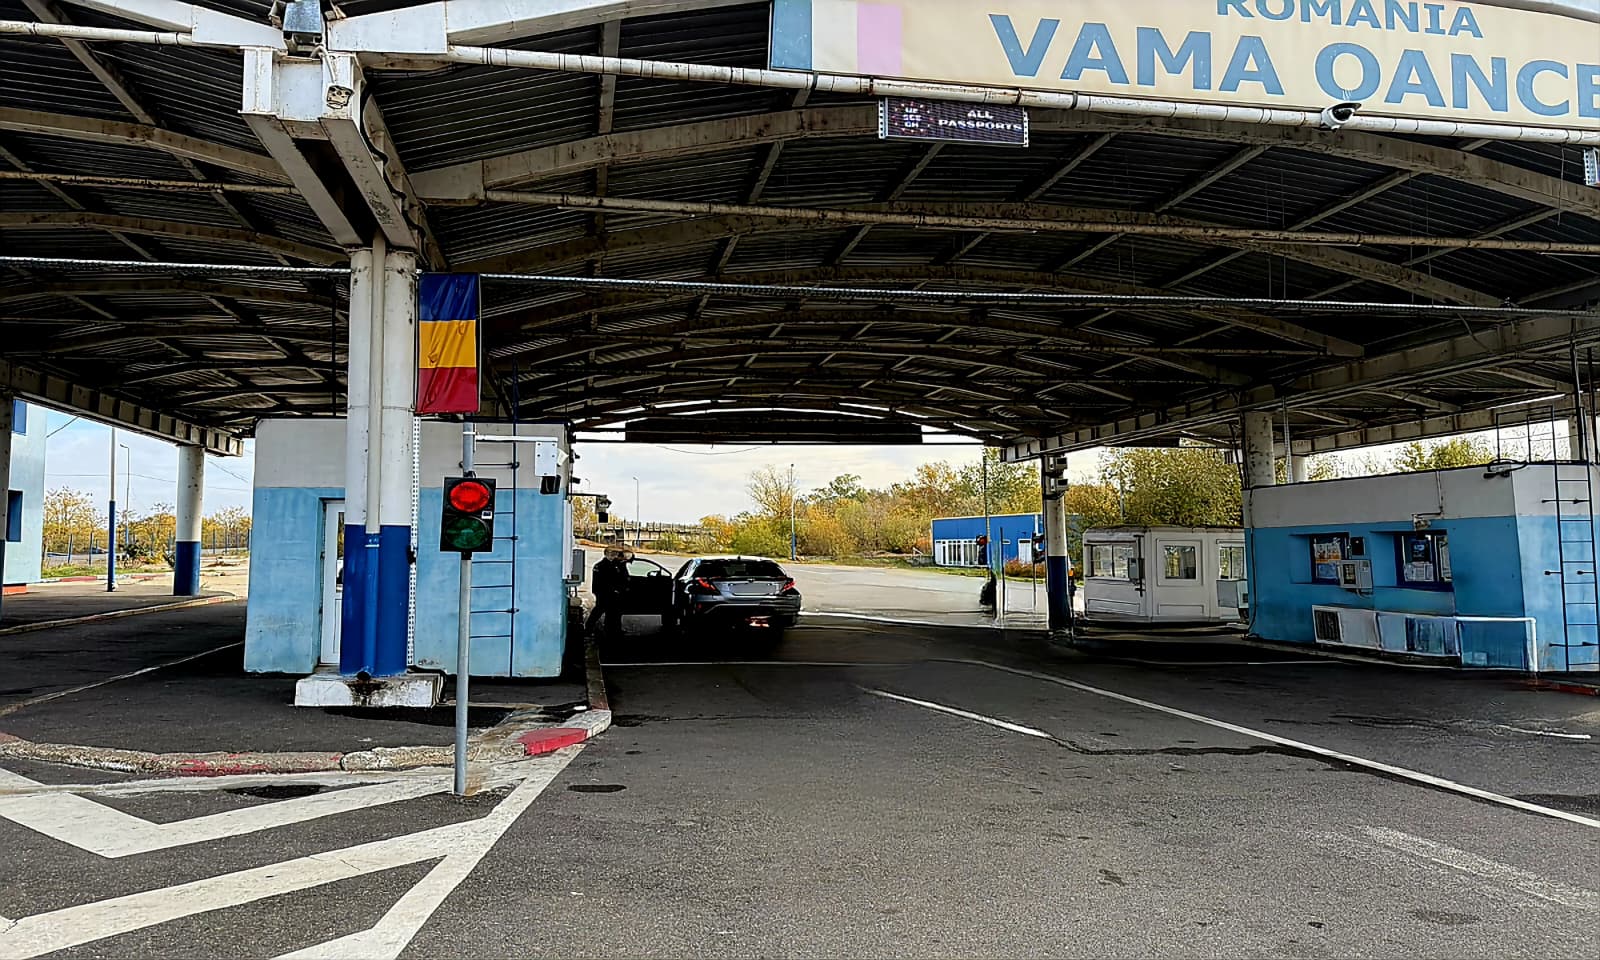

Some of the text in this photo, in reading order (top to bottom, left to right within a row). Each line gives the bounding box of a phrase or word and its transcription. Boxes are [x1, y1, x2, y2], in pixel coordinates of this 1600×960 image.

[990, 14, 1600, 117] VAMA OANCE
[967, 109, 994, 119] ALL
[938, 118, 1023, 131] PASSPORTS
